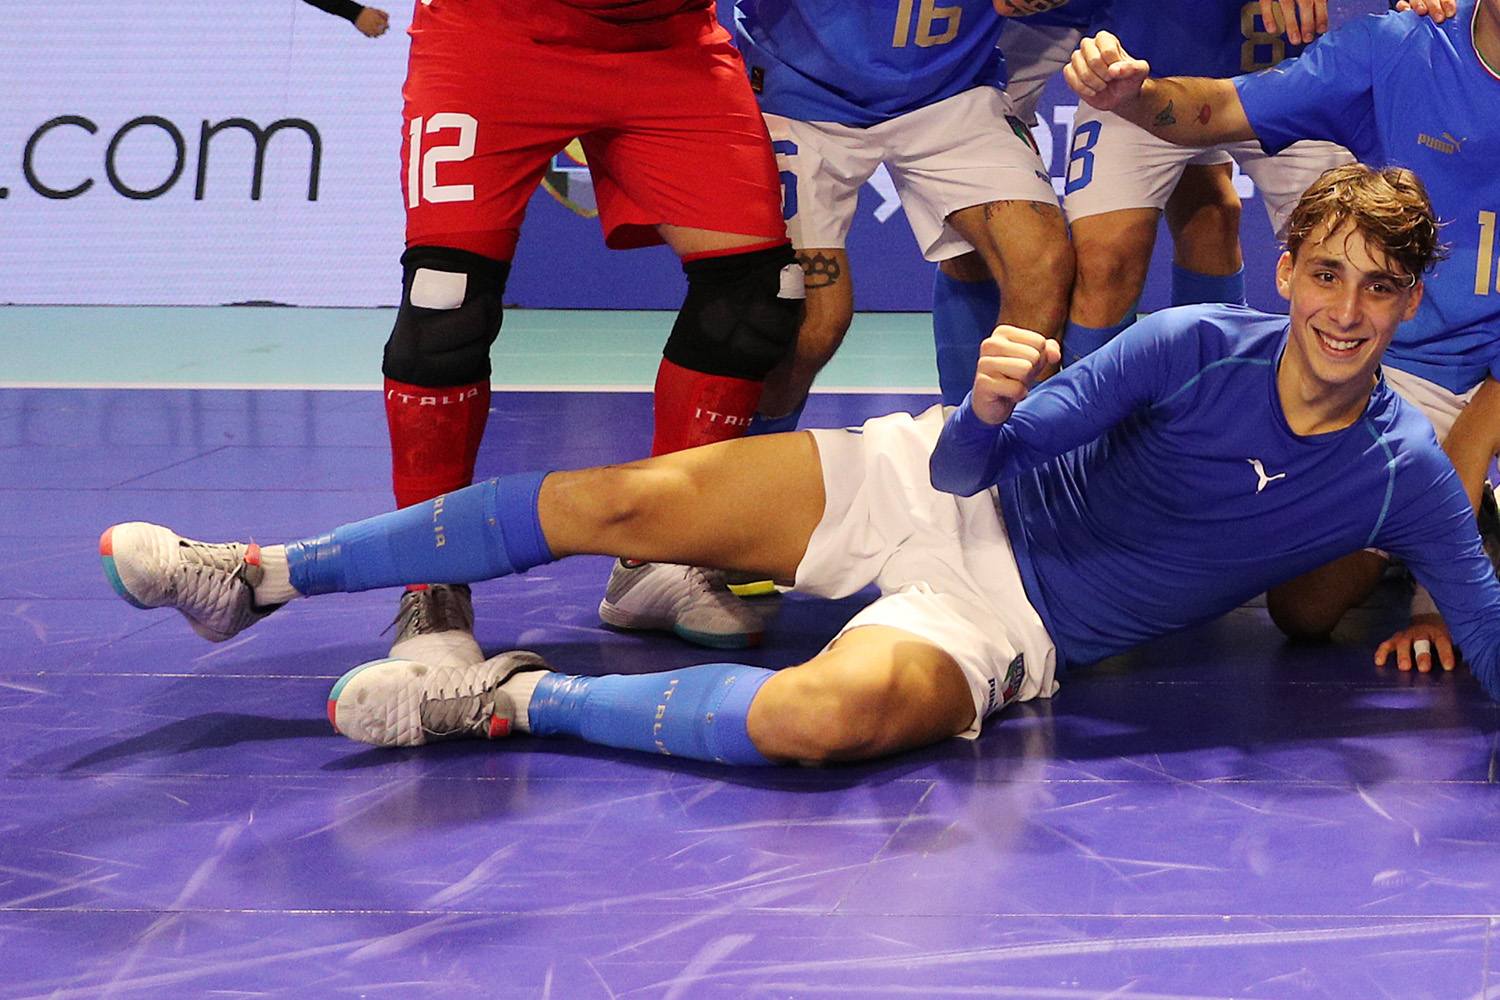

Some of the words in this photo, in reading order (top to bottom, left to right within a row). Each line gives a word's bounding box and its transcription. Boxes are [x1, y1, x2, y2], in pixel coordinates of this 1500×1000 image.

[1240, 1, 1286, 74] 8
[408, 111, 479, 209] 12
[1417, 132, 1455, 155] PUMA
[387, 387, 479, 407] ITALIA
